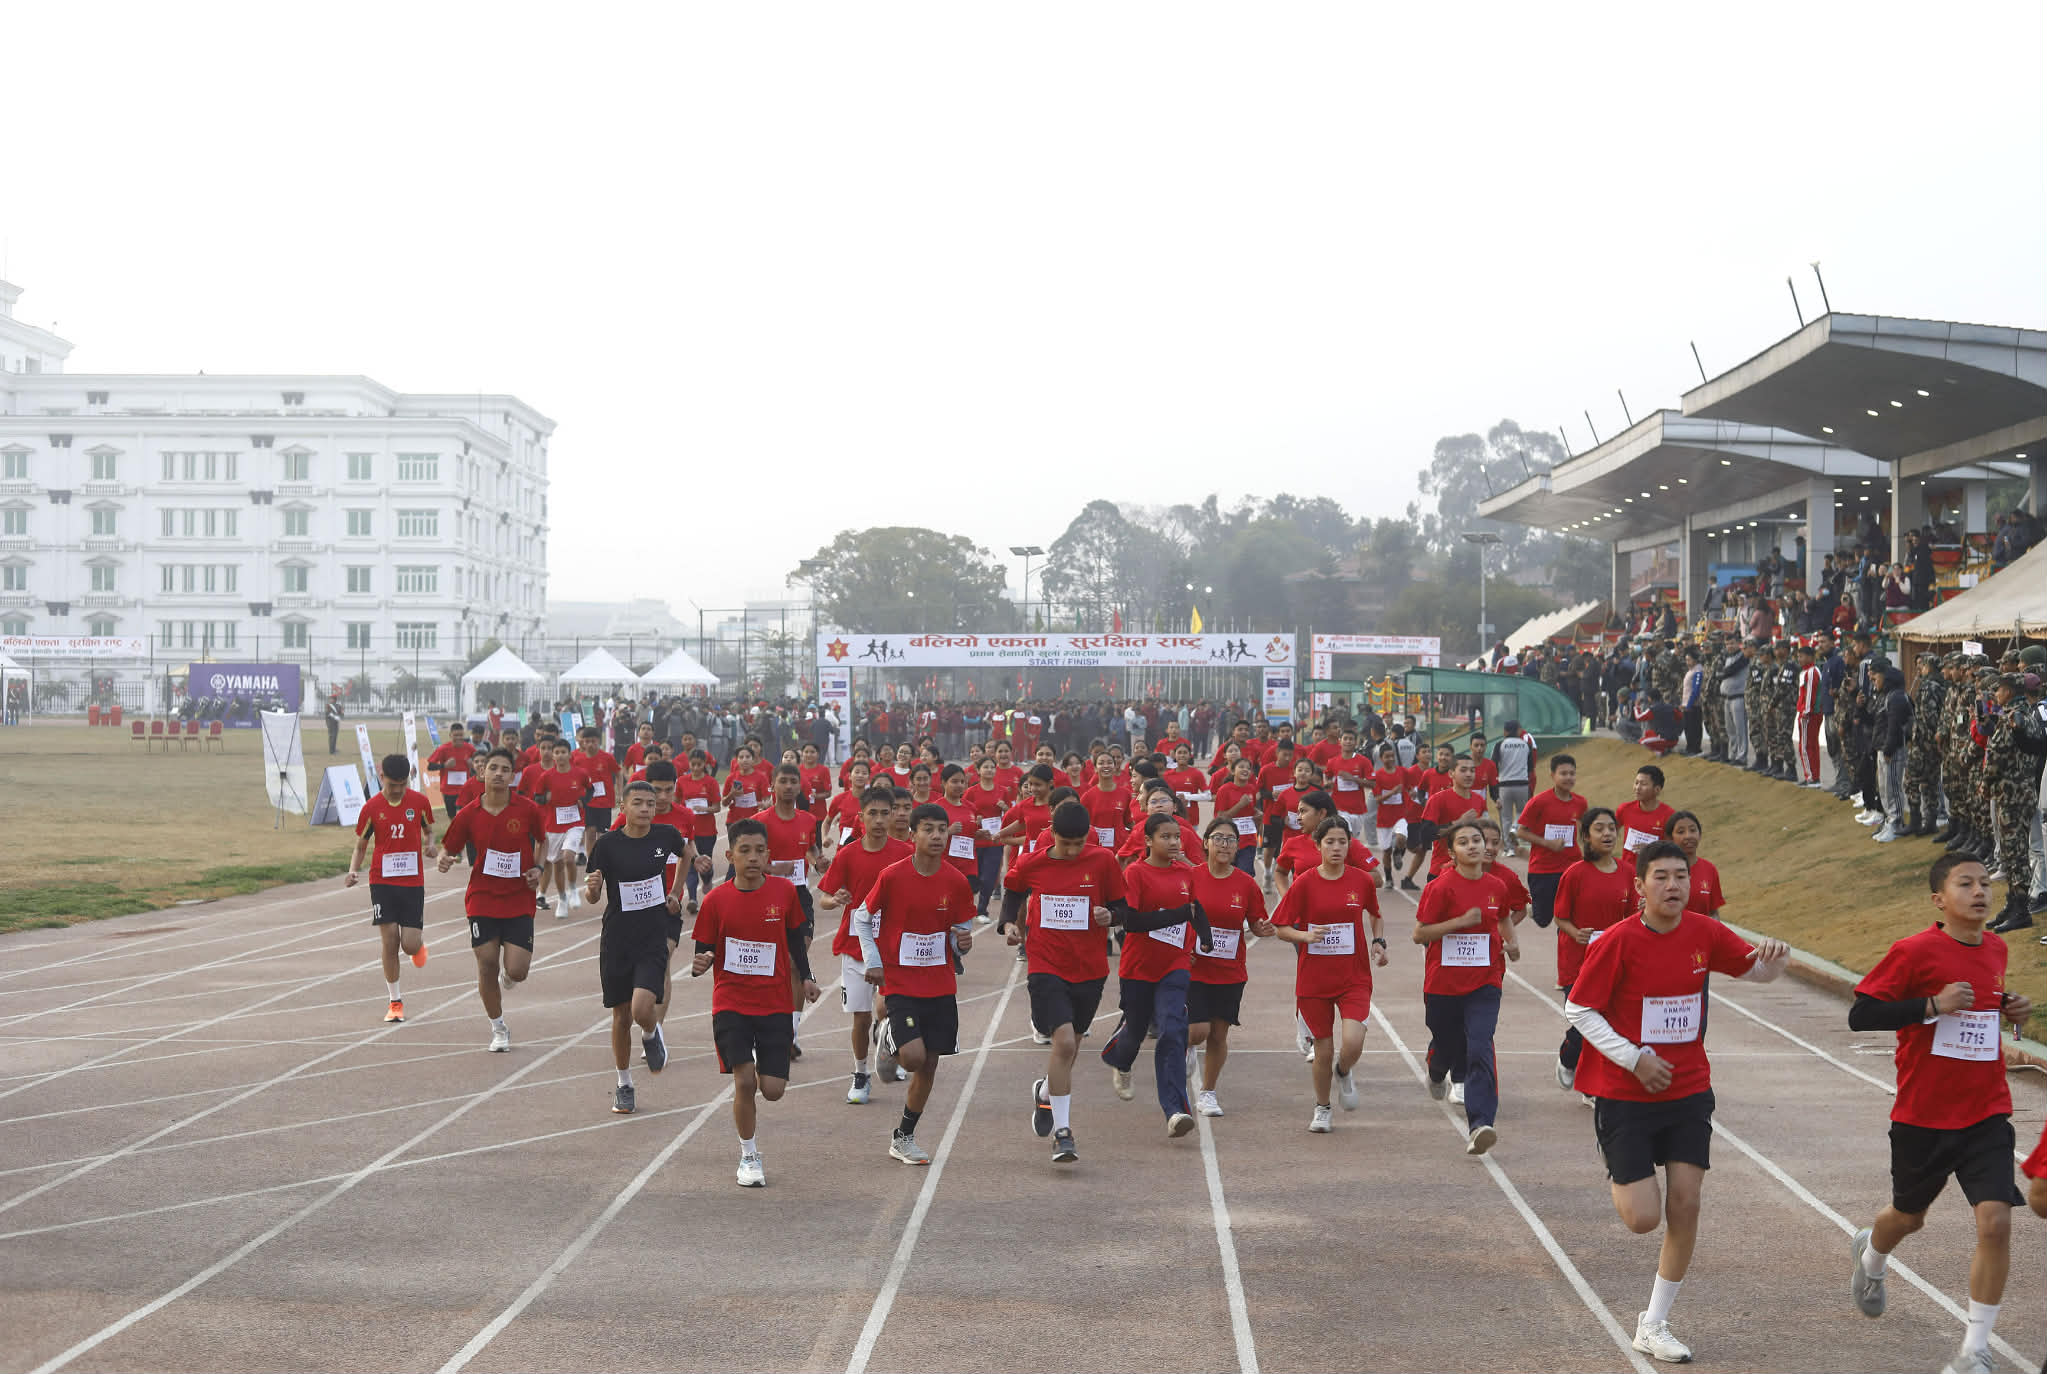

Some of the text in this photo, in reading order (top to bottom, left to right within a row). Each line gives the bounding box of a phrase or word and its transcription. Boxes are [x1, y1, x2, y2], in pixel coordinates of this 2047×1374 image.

[909, 634, 979, 648] बलियो
[1068, 634, 1149, 650] सुरक्षित
[1156, 637, 1204, 650] राष्ट्र
[1028, 658, 1060, 666] START
[1067, 658, 1099, 666] FINISH
[226, 675, 279, 690] YAMAHA
[390, 823, 405, 839] 22
[634, 890, 652, 901] 1755
[1054, 909, 1073, 919] 1693
[1323, 936, 1340, 945] 1655
[1457, 947, 1475, 956] 1721
[739, 954, 759, 964] 1695
[1664, 1016, 1689, 1029] 1718
[1959, 1031, 1985, 1045] 1715
